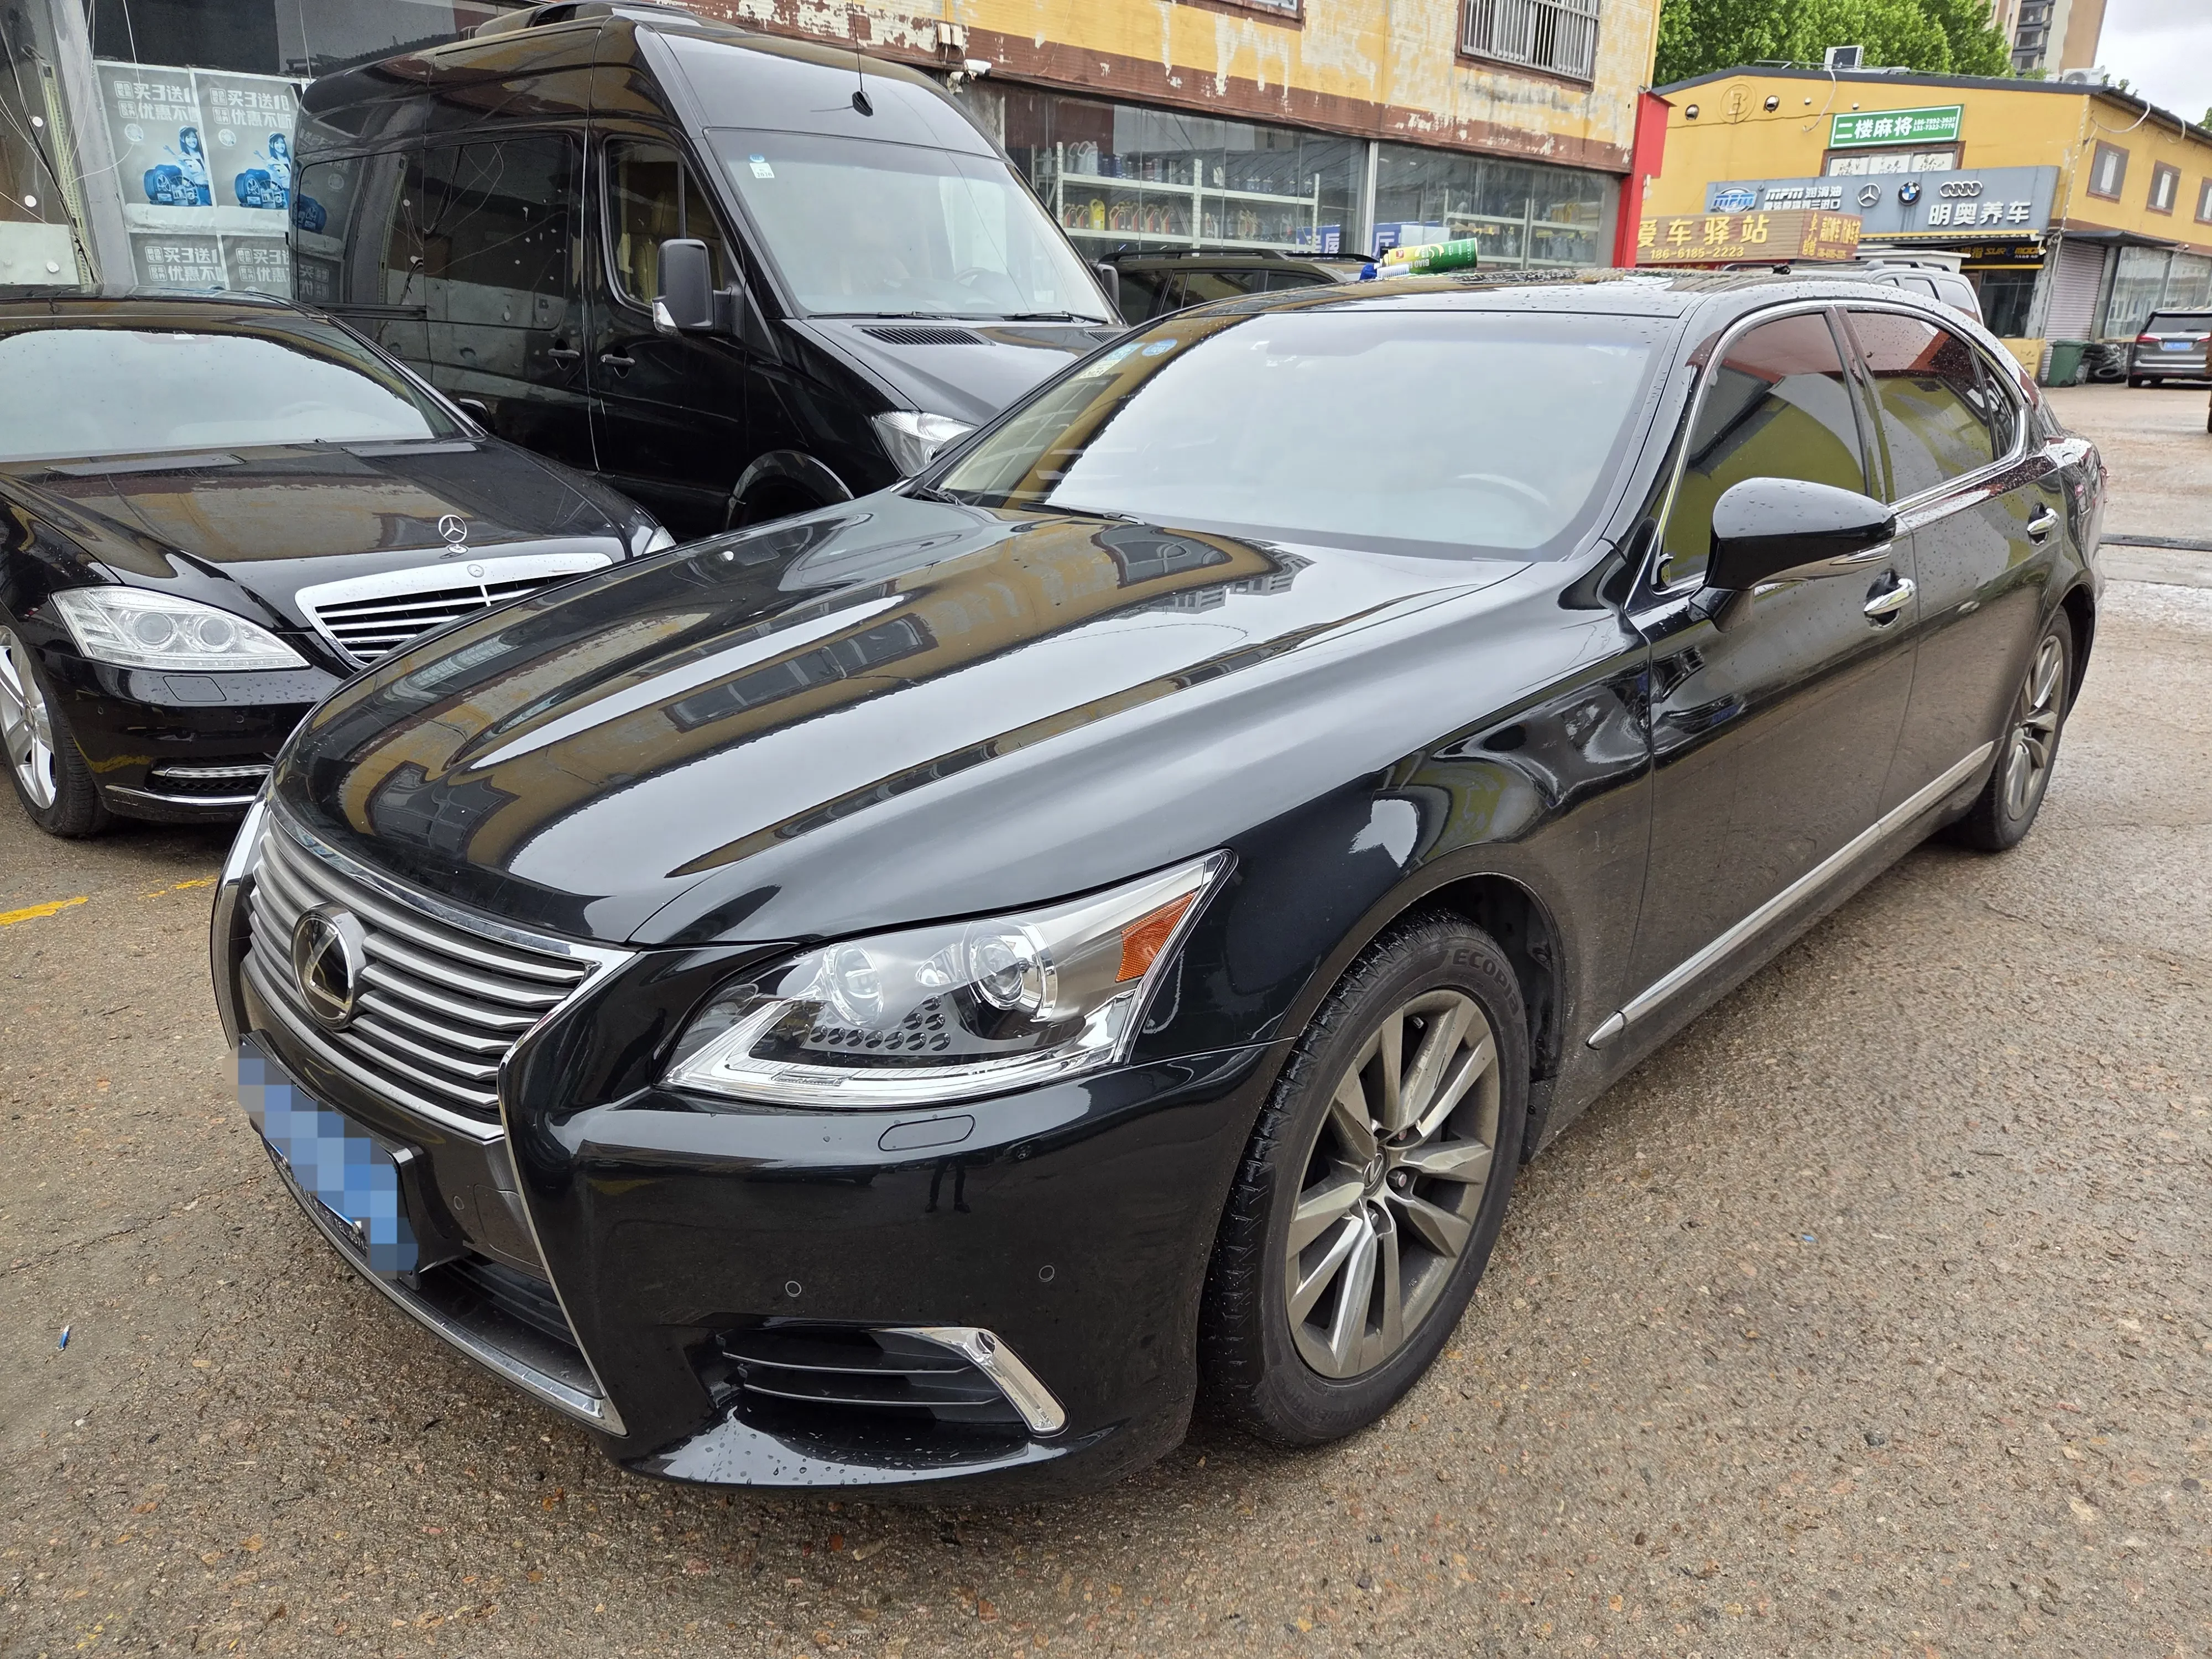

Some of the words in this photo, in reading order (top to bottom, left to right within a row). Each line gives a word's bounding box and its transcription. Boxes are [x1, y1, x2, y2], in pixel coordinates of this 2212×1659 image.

[232, 108, 293, 129] 优惠不断
[1835, 116, 1913, 139] 二楼麻将
[1804, 186, 1843, 199] 润滑油
[1928, 201, 2032, 226] 明奥养车
[1637, 214, 1770, 248] 爱车驿站
[1650, 247, 1745, 260] 186-6185-2223
[1452, 948, 1520, 1016] ECOPIA
